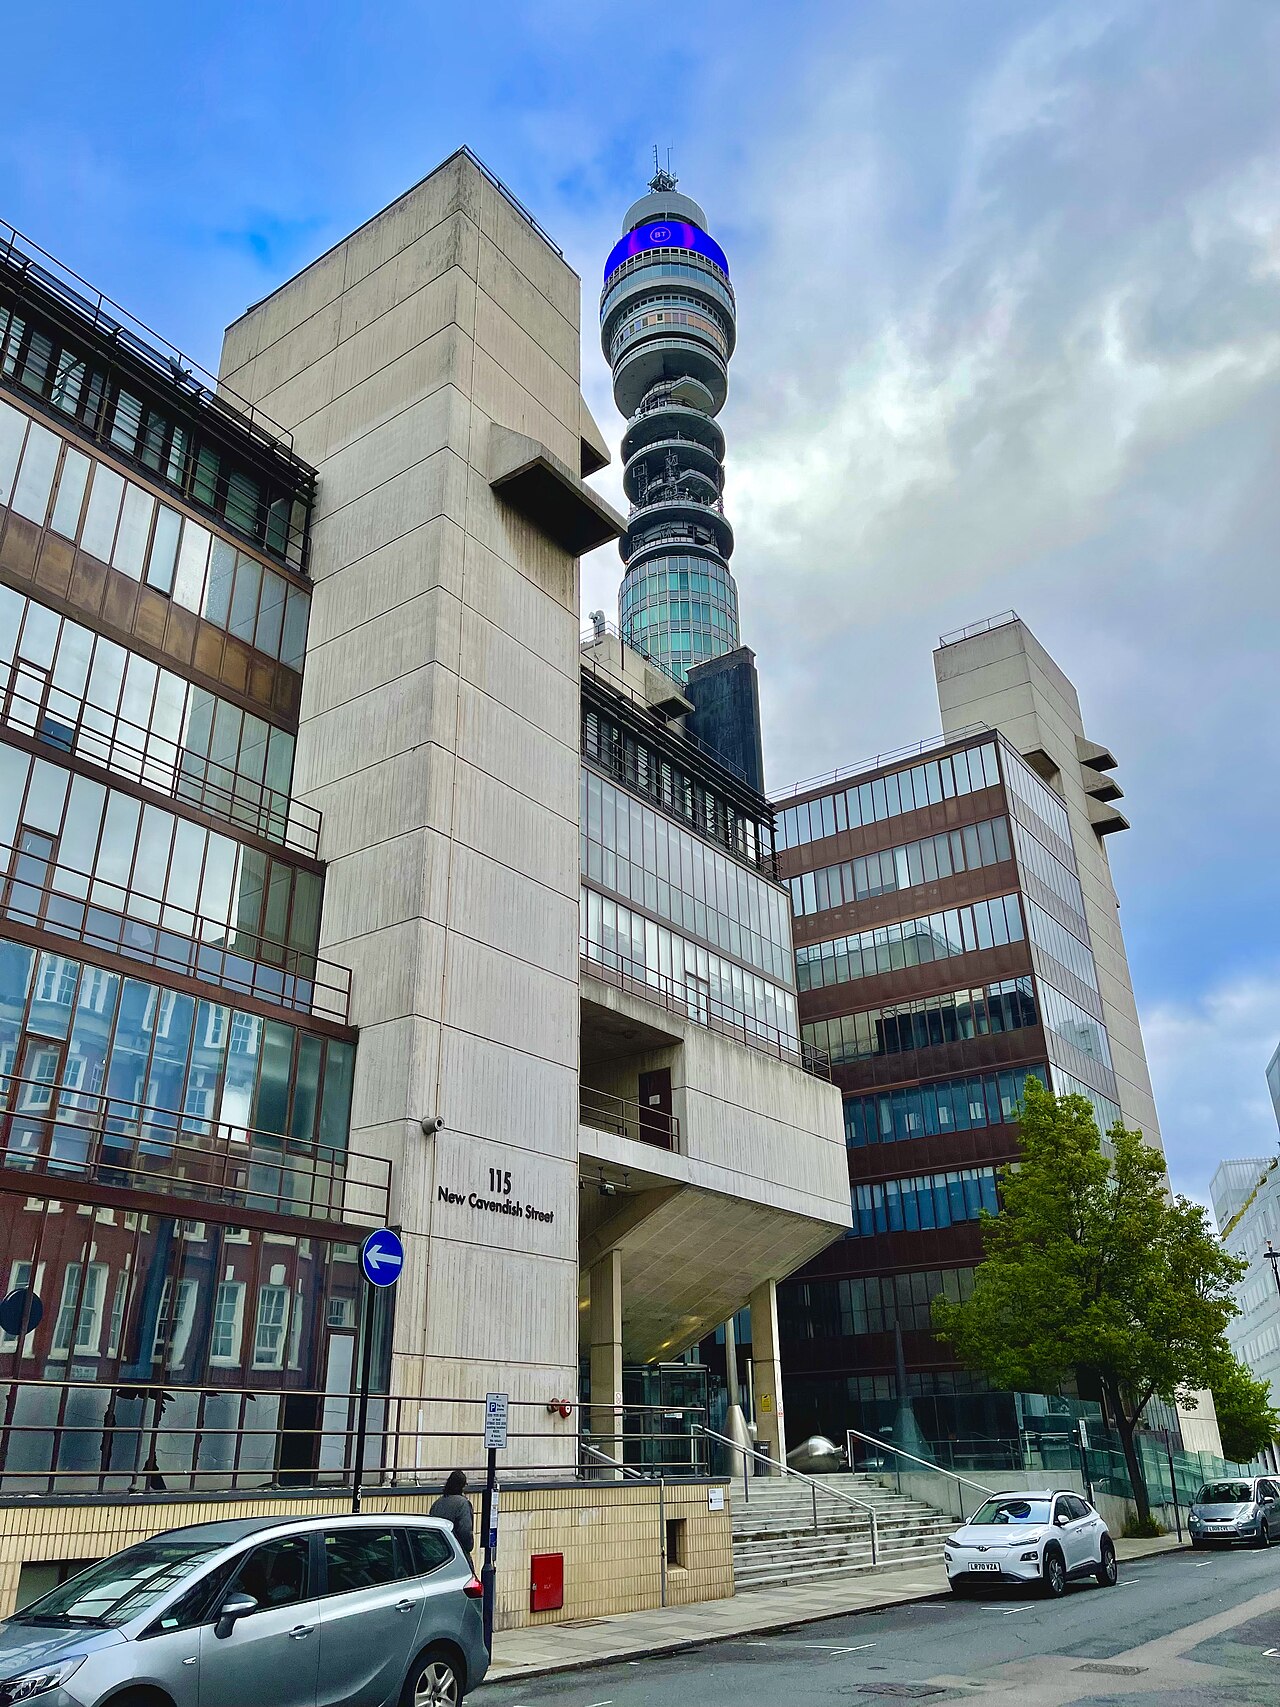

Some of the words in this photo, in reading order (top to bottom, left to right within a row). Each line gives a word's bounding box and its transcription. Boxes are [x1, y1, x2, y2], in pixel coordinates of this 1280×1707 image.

[655, 231, 666, 239] BT
[489, 1168, 512, 1195] 115
[438, 1185, 466, 1206] New
[468, 1193, 523, 1217] Cavendish
[525, 1204, 555, 1223] Street
[490, 1403, 496, 1412] P
